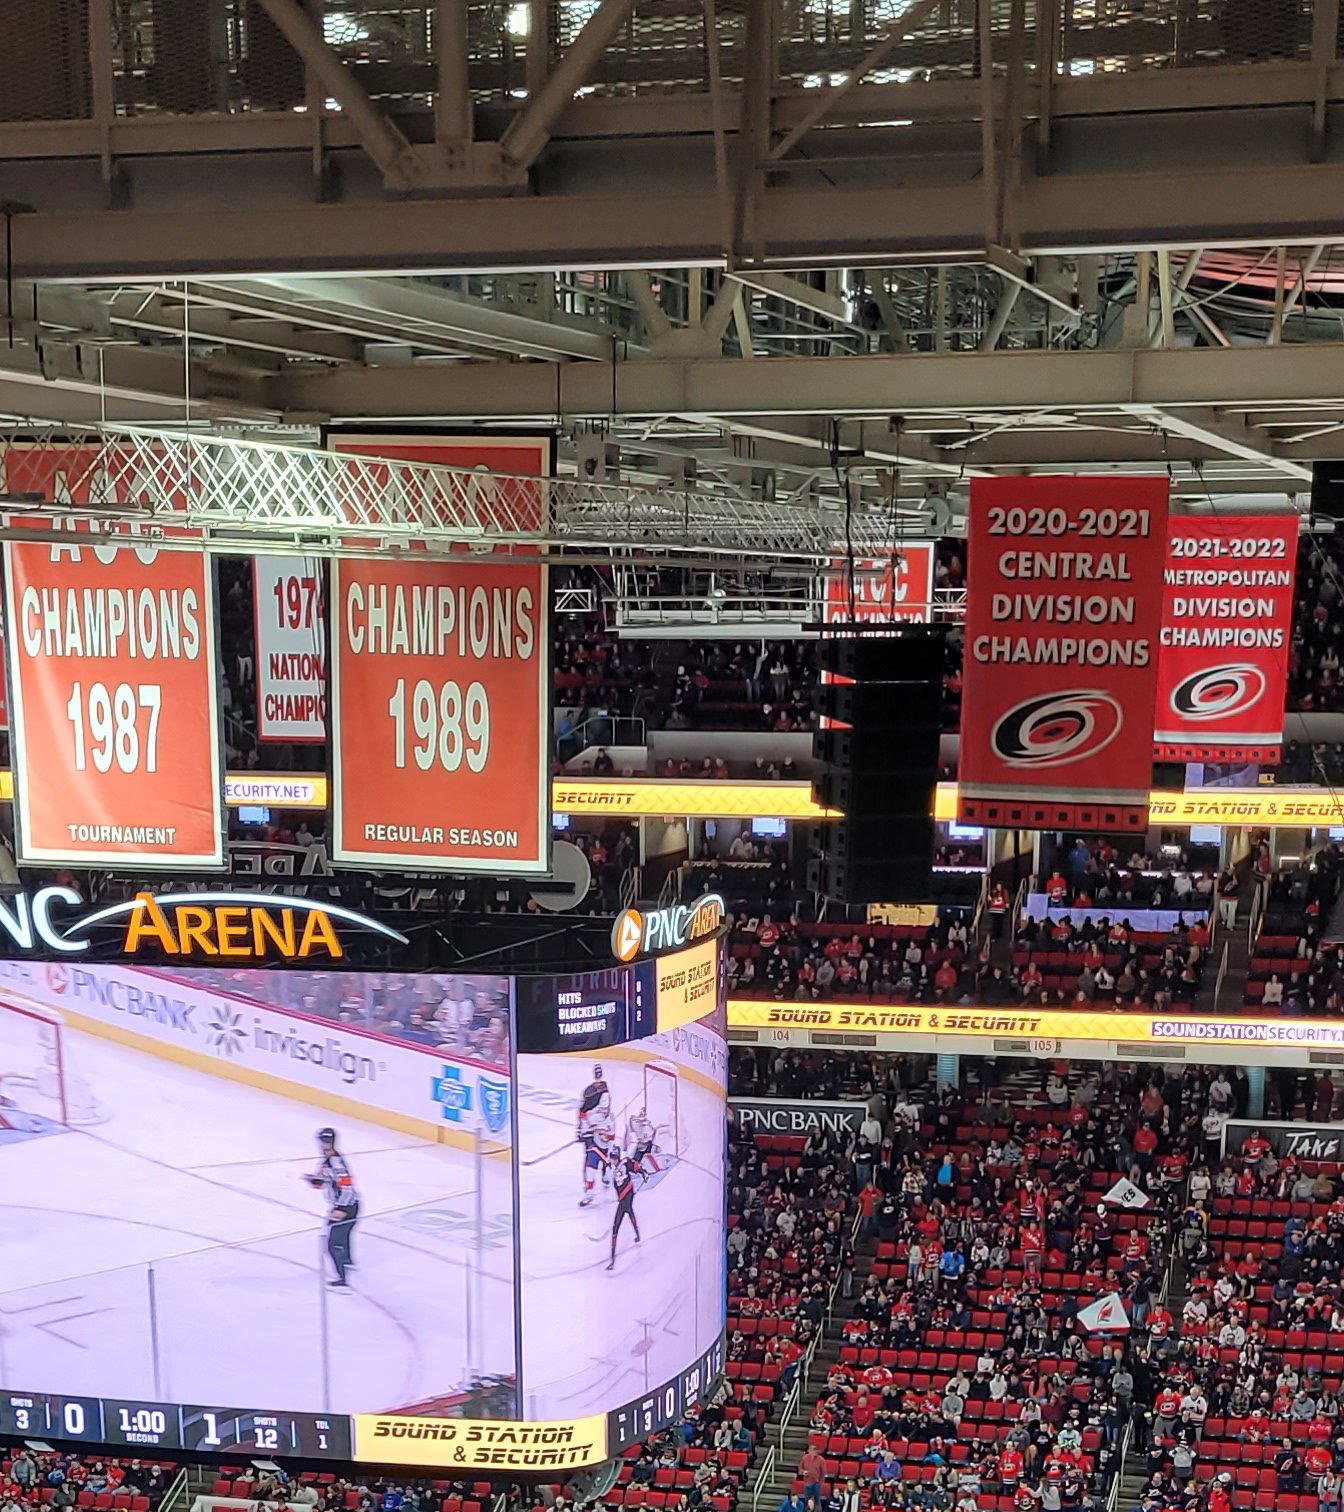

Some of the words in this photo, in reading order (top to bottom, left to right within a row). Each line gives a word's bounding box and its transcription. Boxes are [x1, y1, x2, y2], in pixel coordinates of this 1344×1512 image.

[988, 508, 1150, 537] 2020-2021
[1170, 538, 1286, 558] 2021-2022
[999, 551, 1132, 580] CENTRAL
[1163, 568, 1290, 586] METROPOLITAN
[992, 594, 1136, 623] DIVISION
[1172, 597, 1274, 618] DIVISION
[22, 586, 200, 660] CHAMPIONS
[347, 581, 535, 660] CHAMPIONS
[1159, 627, 1284, 648] CHAMPIONS
[972, 634, 1151, 667] CHAMPIONS
[67, 681, 161, 774] 1987
[388, 678, 490, 773] 1989
[556, 791, 636, 805] SECURITY
[1183, 802, 1260, 815] STATION
[1267, 802, 1279, 816] &
[67, 824, 176, 844] TOURNAMENT
[364, 823, 444, 845] REGULAR
[449, 828, 518, 848] SEASON
[123, 891, 344, 957] ARENA
[644, 904, 687, 952] PNC
[558, 992, 582, 1005] HITS
[558, 1005, 597, 1020] BLOCKED
[597, 1002, 616, 1016] SHOTS
[558, 1018, 607, 1035] TAKEAWAYS
[768, 1008, 832, 1024] SOUND
[838, 1011, 922, 1027] STATION
[928, 1013, 939, 1027] &
[944, 1016, 1041, 1032] SECURITY
[772, 1030, 790, 1041] 104
[253, 1017, 377, 1085] invisalign
[1285, 1131, 1340, 1158] TAKE
[16, 1408, 29, 1429] 3
[125, 1432, 159, 1444] SECOND
[254, 1428, 278, 1449] 12
[319, 1434, 328, 1449] 1
[64, 1402, 85, 1434] 0
[118, 1408, 166, 1434] 1:00
[203, 1413, 221, 1445] 1
[374, 1421, 458, 1441] SOUND
[465, 1425, 575, 1444] STATION
[453, 1445, 467, 1463] &
[473, 1443, 594, 1465] SECURITY
